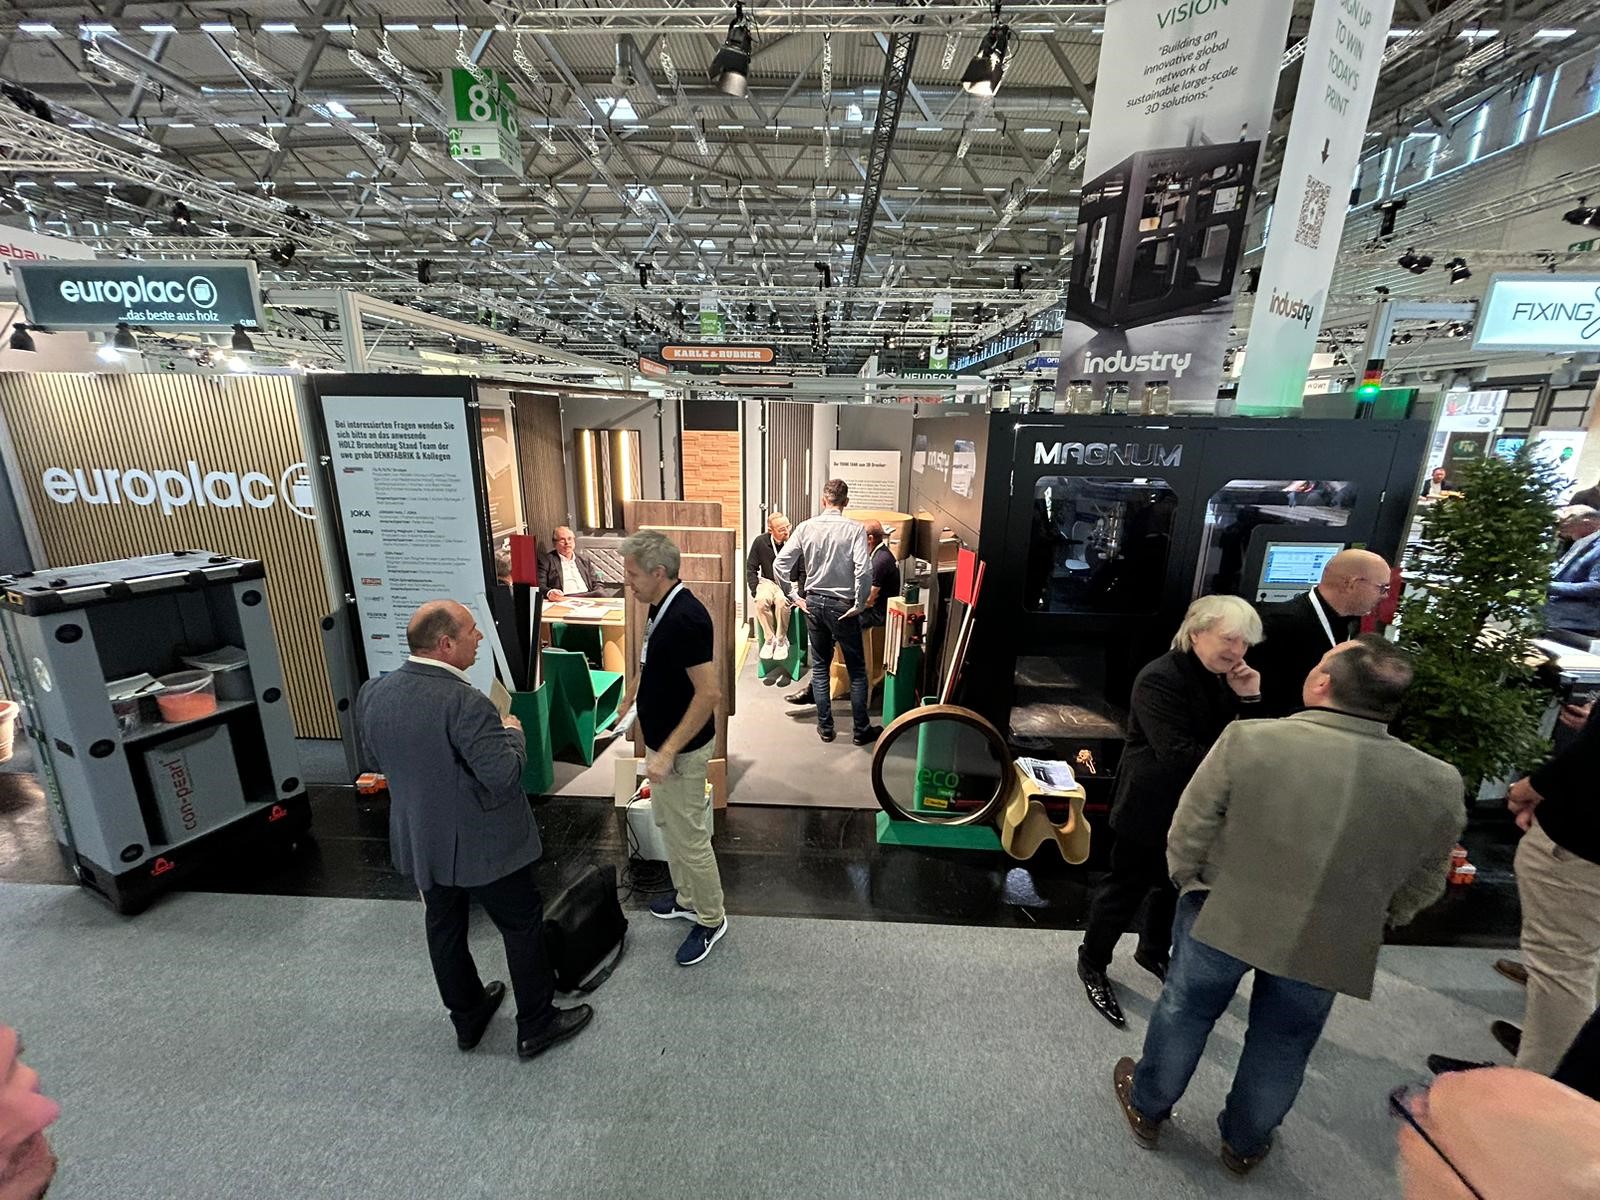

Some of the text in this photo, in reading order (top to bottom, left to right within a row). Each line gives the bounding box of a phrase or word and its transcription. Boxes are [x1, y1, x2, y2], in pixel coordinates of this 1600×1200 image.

[1341, 0, 1372, 30] GN UP
[1203, 30, 1218, 41] an
[1336, 18, 1364, 60] TO WIN
[1143, 38, 1229, 76] innovative global
[1155, 58, 1211, 85] network of
[1126, 65, 1238, 108] sustainable large-scale
[468, 84, 492, 121] 8
[1144, 103, 1160, 115] 3D
[1325, 84, 1350, 116] PRINT
[60, 275, 186, 308] europlac
[146, 309, 176, 321] beste
[176, 312, 196, 321] aus
[195, 309, 220, 321] holz
[1269, 286, 1314, 329] industry
[1512, 302, 1595, 321] FIXING
[673, 349, 707, 358] KARLE
[709, 350, 719, 358] &
[1083, 350, 1192, 378] industry
[335, 420, 455, 431] Bei interessierten Fragen wenden Sie
[336, 431, 350, 439] sich
[351, 431, 367, 439] bitte
[377, 431, 390, 440] das
[391, 431, 426, 440] anwesende
[338, 441, 449, 451] HOLZ Branchentag Stand Team der
[340, 452, 353, 460] uwe
[373, 451, 415, 460] DENKFABRIK
[415, 451, 421, 460] &
[422, 451, 451, 462] Kollegen
[1033, 441, 1183, 467] MAGNUM
[42, 460, 276, 516] europlac
[350, 509, 371, 518] JOKA
[917, 768, 960, 788] eco
